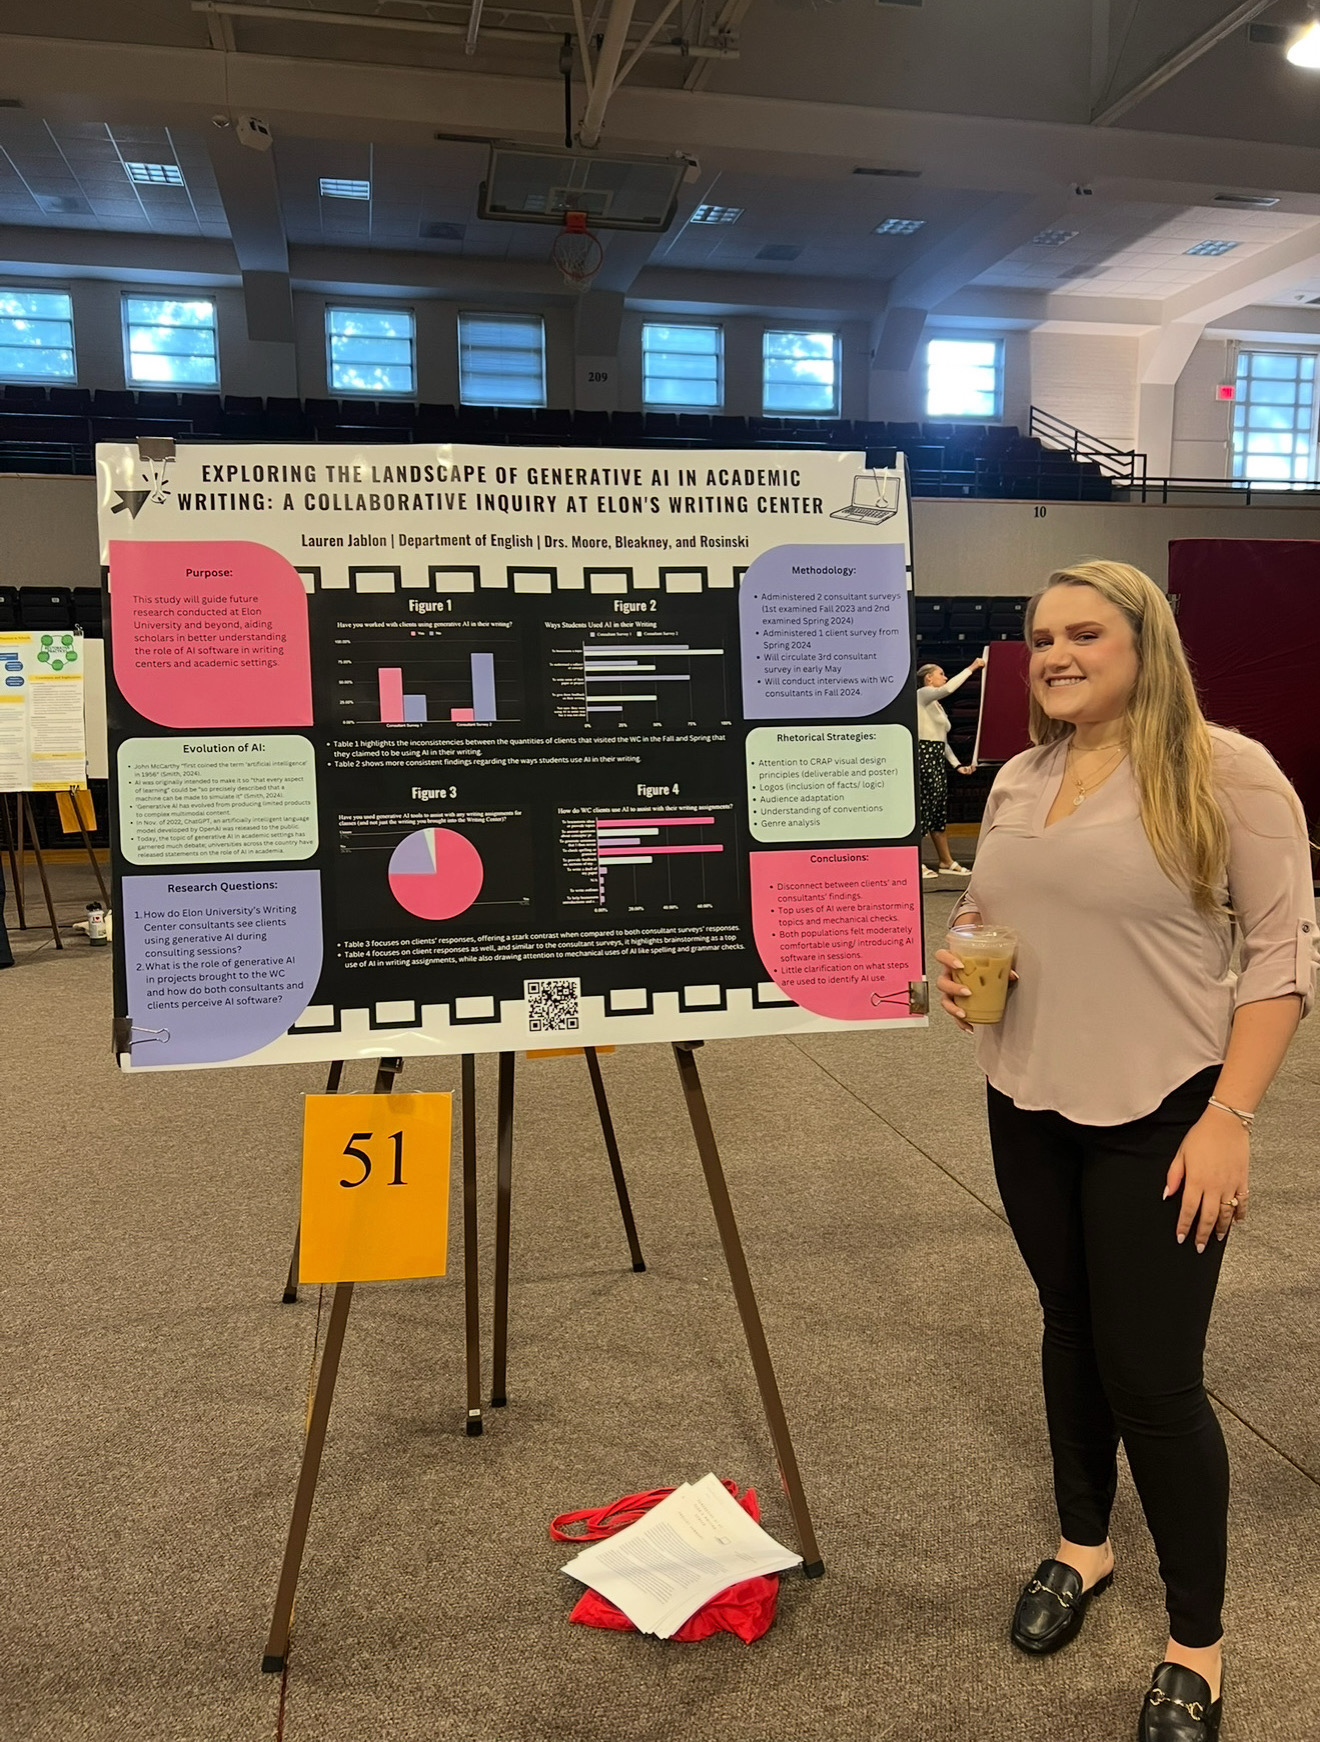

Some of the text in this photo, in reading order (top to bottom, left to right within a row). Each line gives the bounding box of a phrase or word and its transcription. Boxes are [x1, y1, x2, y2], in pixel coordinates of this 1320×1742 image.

[588, 372, 608, 382] 209
[202, 465, 800, 487] EXPLORING THE LANDSCAPE OF GENERATIVE AI IN ACADEMIC
[178, 493, 823, 514] WRITING: A COLLABORATIVE INQUIRY AT ELON'S WRITING CENTER
[1034, 506, 1047, 518] 10
[302, 534, 749, 550] Lauren Jablon Department of English Drs. Moore, Bleakney, and Rosinski
[186, 569, 233, 579] Purpose:
[792, 566, 857, 576] Methodology:
[133, 595, 258, 605] This study will guide future
[761, 593, 816, 601] Administered
[817, 593, 822, 601] 2
[824, 593, 867, 601] consultant
[409, 599, 452, 614] Figure 1
[614, 600, 657, 614] Figure 2
[762, 605, 777, 613] (1st
[778, 605, 817, 613] examined
[835, 605, 856, 613] 2023
[133, 608, 175, 617] research
[177, 608, 227, 617] conducted
[241, 608, 262, 616] Elon
[134, 620, 273, 631] University and beyond, aiding
[762, 617, 854, 626] examined Spring 2024)
[134, 634, 174, 642] scholars
[188, 633, 217, 642] better
[219, 633, 287, 643] understanding
[135, 647, 151, 655] the
[153, 647, 172, 655] role
[174, 646, 184, 655] of
[198, 646, 239, 654] software
[241, 646, 250, 654] in
[252, 645, 284, 656] writing
[174, 660, 191, 668] and
[194, 659, 239, 667] academic
[241, 658, 279, 668] settings.
[777, 732, 877, 742] Rhetorical Strategies:
[183, 743, 266, 753] Evolution of AI:
[334, 751, 351, 759] they
[759, 759, 798, 767] Attention
[834, 757, 858, 765] visual
[860, 757, 886, 766] design
[759, 771, 800, 780] principles
[801, 769, 849, 778] (deliverable
[868, 768, 898, 777] poster)
[412, 786, 457, 801] Figure 3
[637, 783, 680, 798] Figure 4
[800, 794, 845, 803] adaptation
[761, 807, 821, 816] Understanding
[822, 805, 831, 814] of
[788, 819, 821, 828] analysis
[810, 854, 869, 863] Conclusions:
[168, 881, 278, 893] Research Questions:
[777, 882, 823, 891] Disconnect
[861, 879, 890, 887] clients'
[777, 892, 863, 902] consultants' findings.
[167, 910, 180, 918] do
[183, 909, 203, 917] Elon
[206, 906, 261, 916] University's
[263, 906, 297, 915] Writing
[144, 924, 177, 932] Center
[179, 921, 235, 930] consultants
[255, 919, 287, 927] clients
[144, 933, 267, 946] using generative AI during
[145, 946, 242, 958] consulting sessions?
[145, 962, 170, 970] What
[173, 961, 181, 969] is
[183, 961, 199, 969] the
[201, 960, 220, 968] role
[222, 958, 232, 967] of
[234, 957, 284, 969] generative
[286, 956, 295, 964] AI
[340, 1131, 408, 1187] 51
